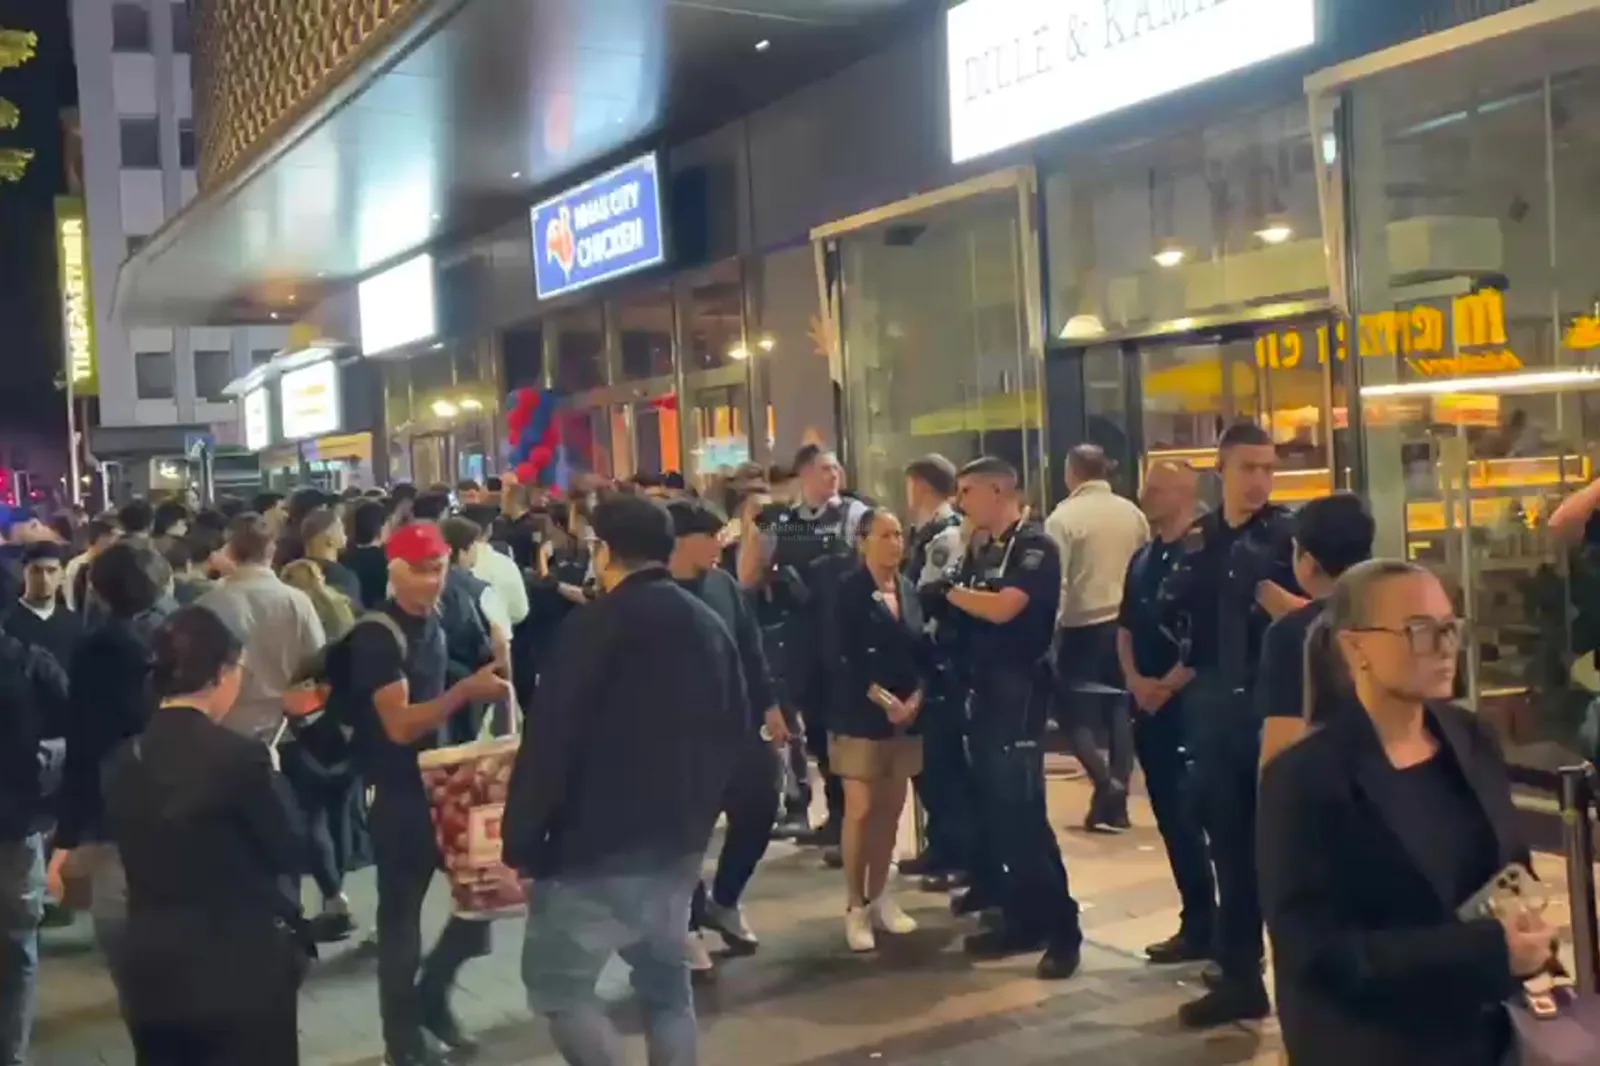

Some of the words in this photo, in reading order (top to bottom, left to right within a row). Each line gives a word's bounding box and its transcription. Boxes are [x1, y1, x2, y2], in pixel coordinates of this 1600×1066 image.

[964, 25, 1052, 103] DILLE
[1066, 13, 1089, 62] &
[576, 216, 645, 268] CHICKEN
